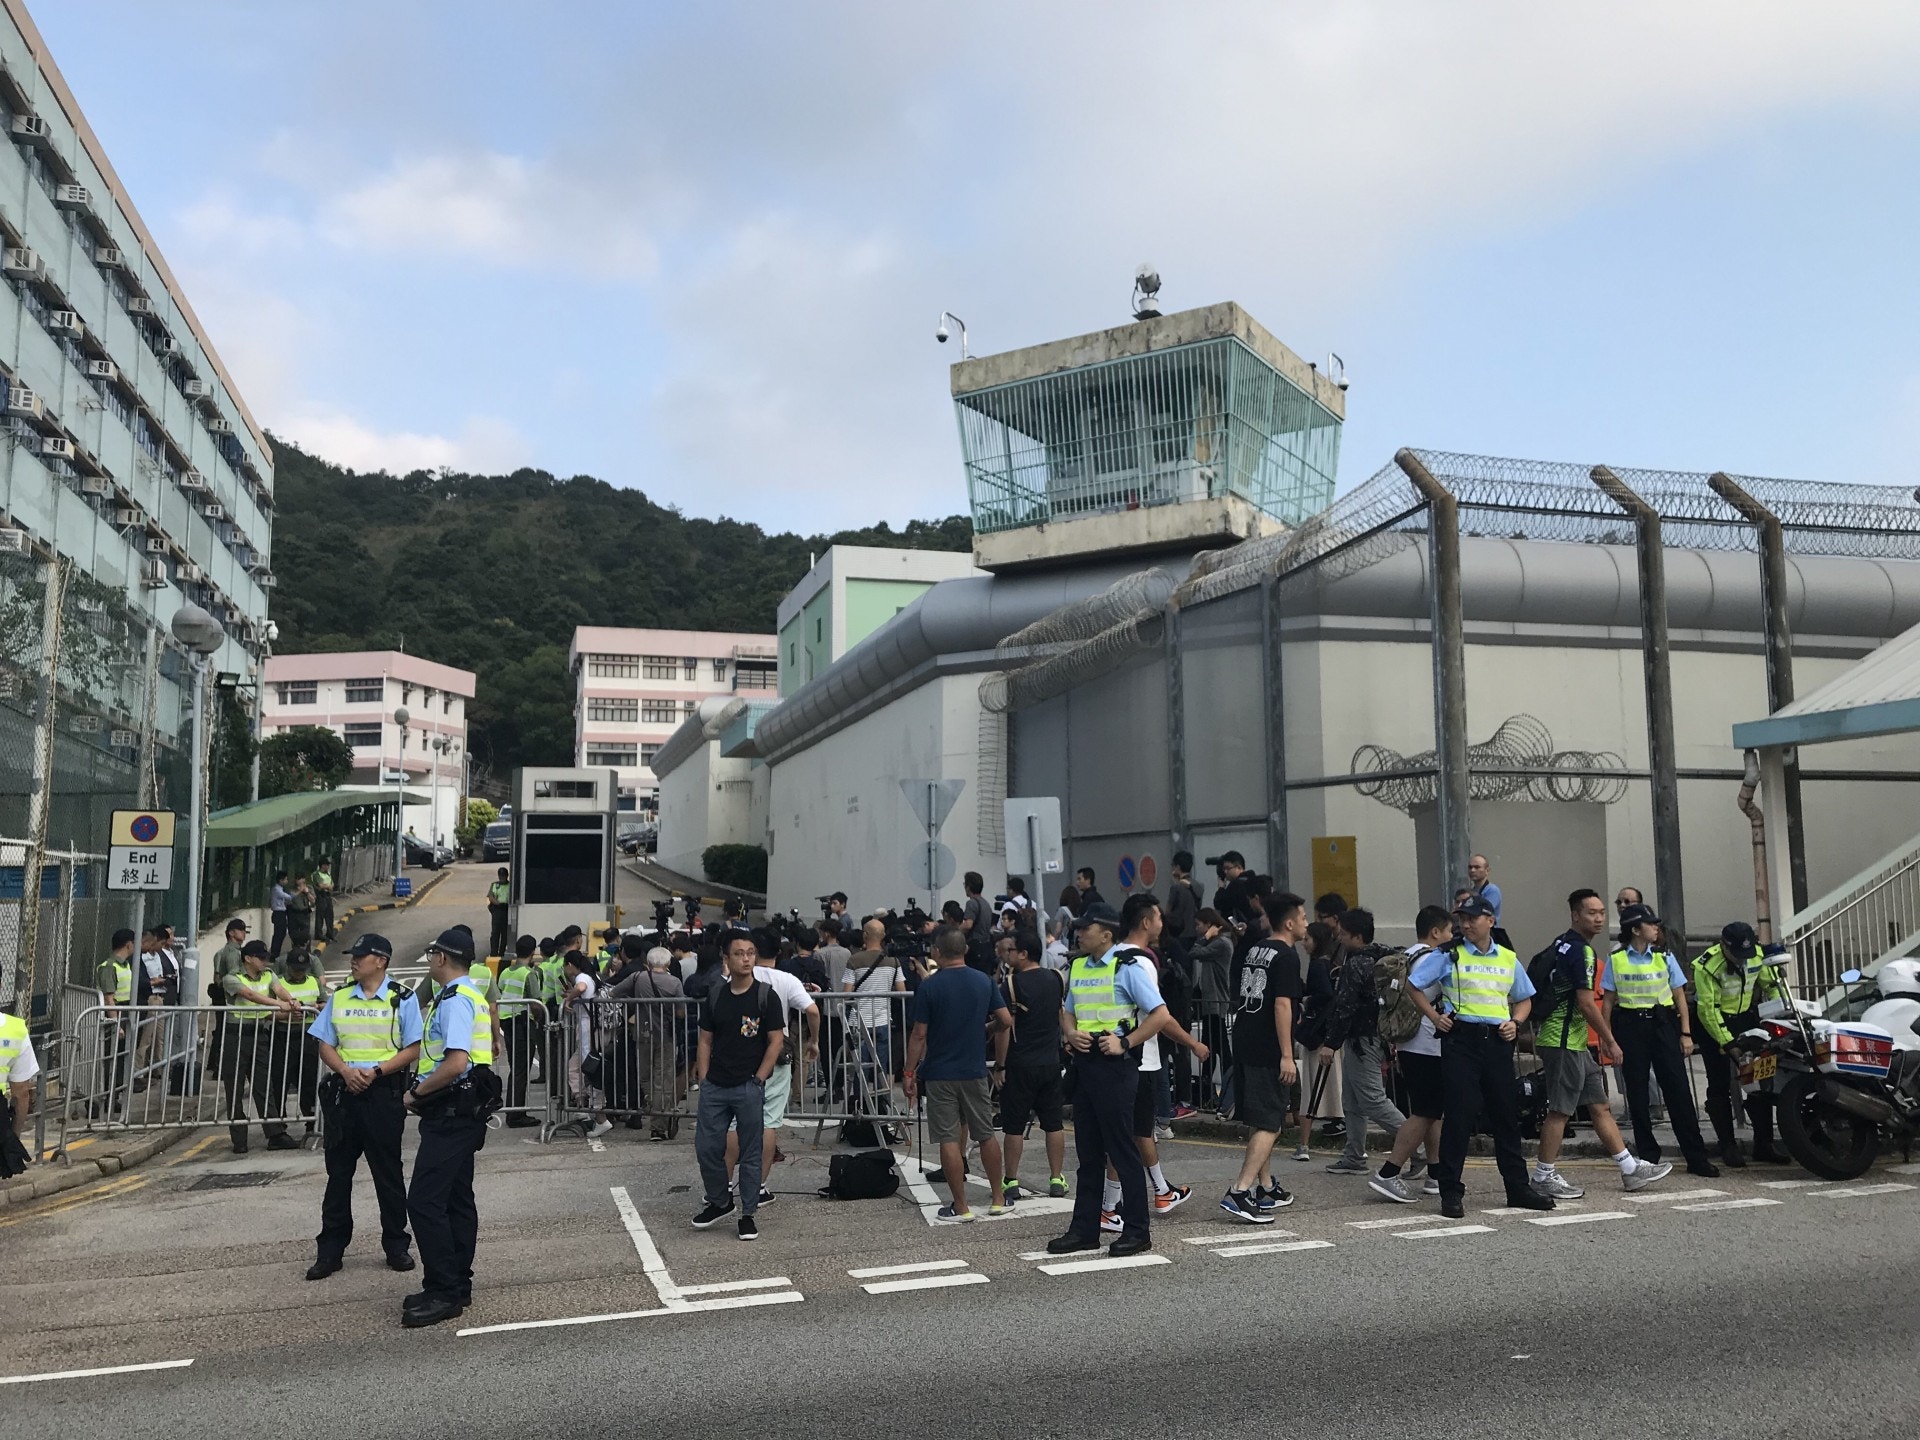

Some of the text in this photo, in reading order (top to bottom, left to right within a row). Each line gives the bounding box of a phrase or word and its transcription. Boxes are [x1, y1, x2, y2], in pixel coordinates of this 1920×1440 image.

[129, 851, 157, 864] End
[121, 868, 159, 885] 終止
[1473, 965, 1498, 974] POLICE
[352, 1009, 378, 1017] POLICE
[1760, 1057, 1772, 1068] AM
[1848, 1050, 1882, 1066] POLICE
[1754, 1066, 1776, 1078] 7552
